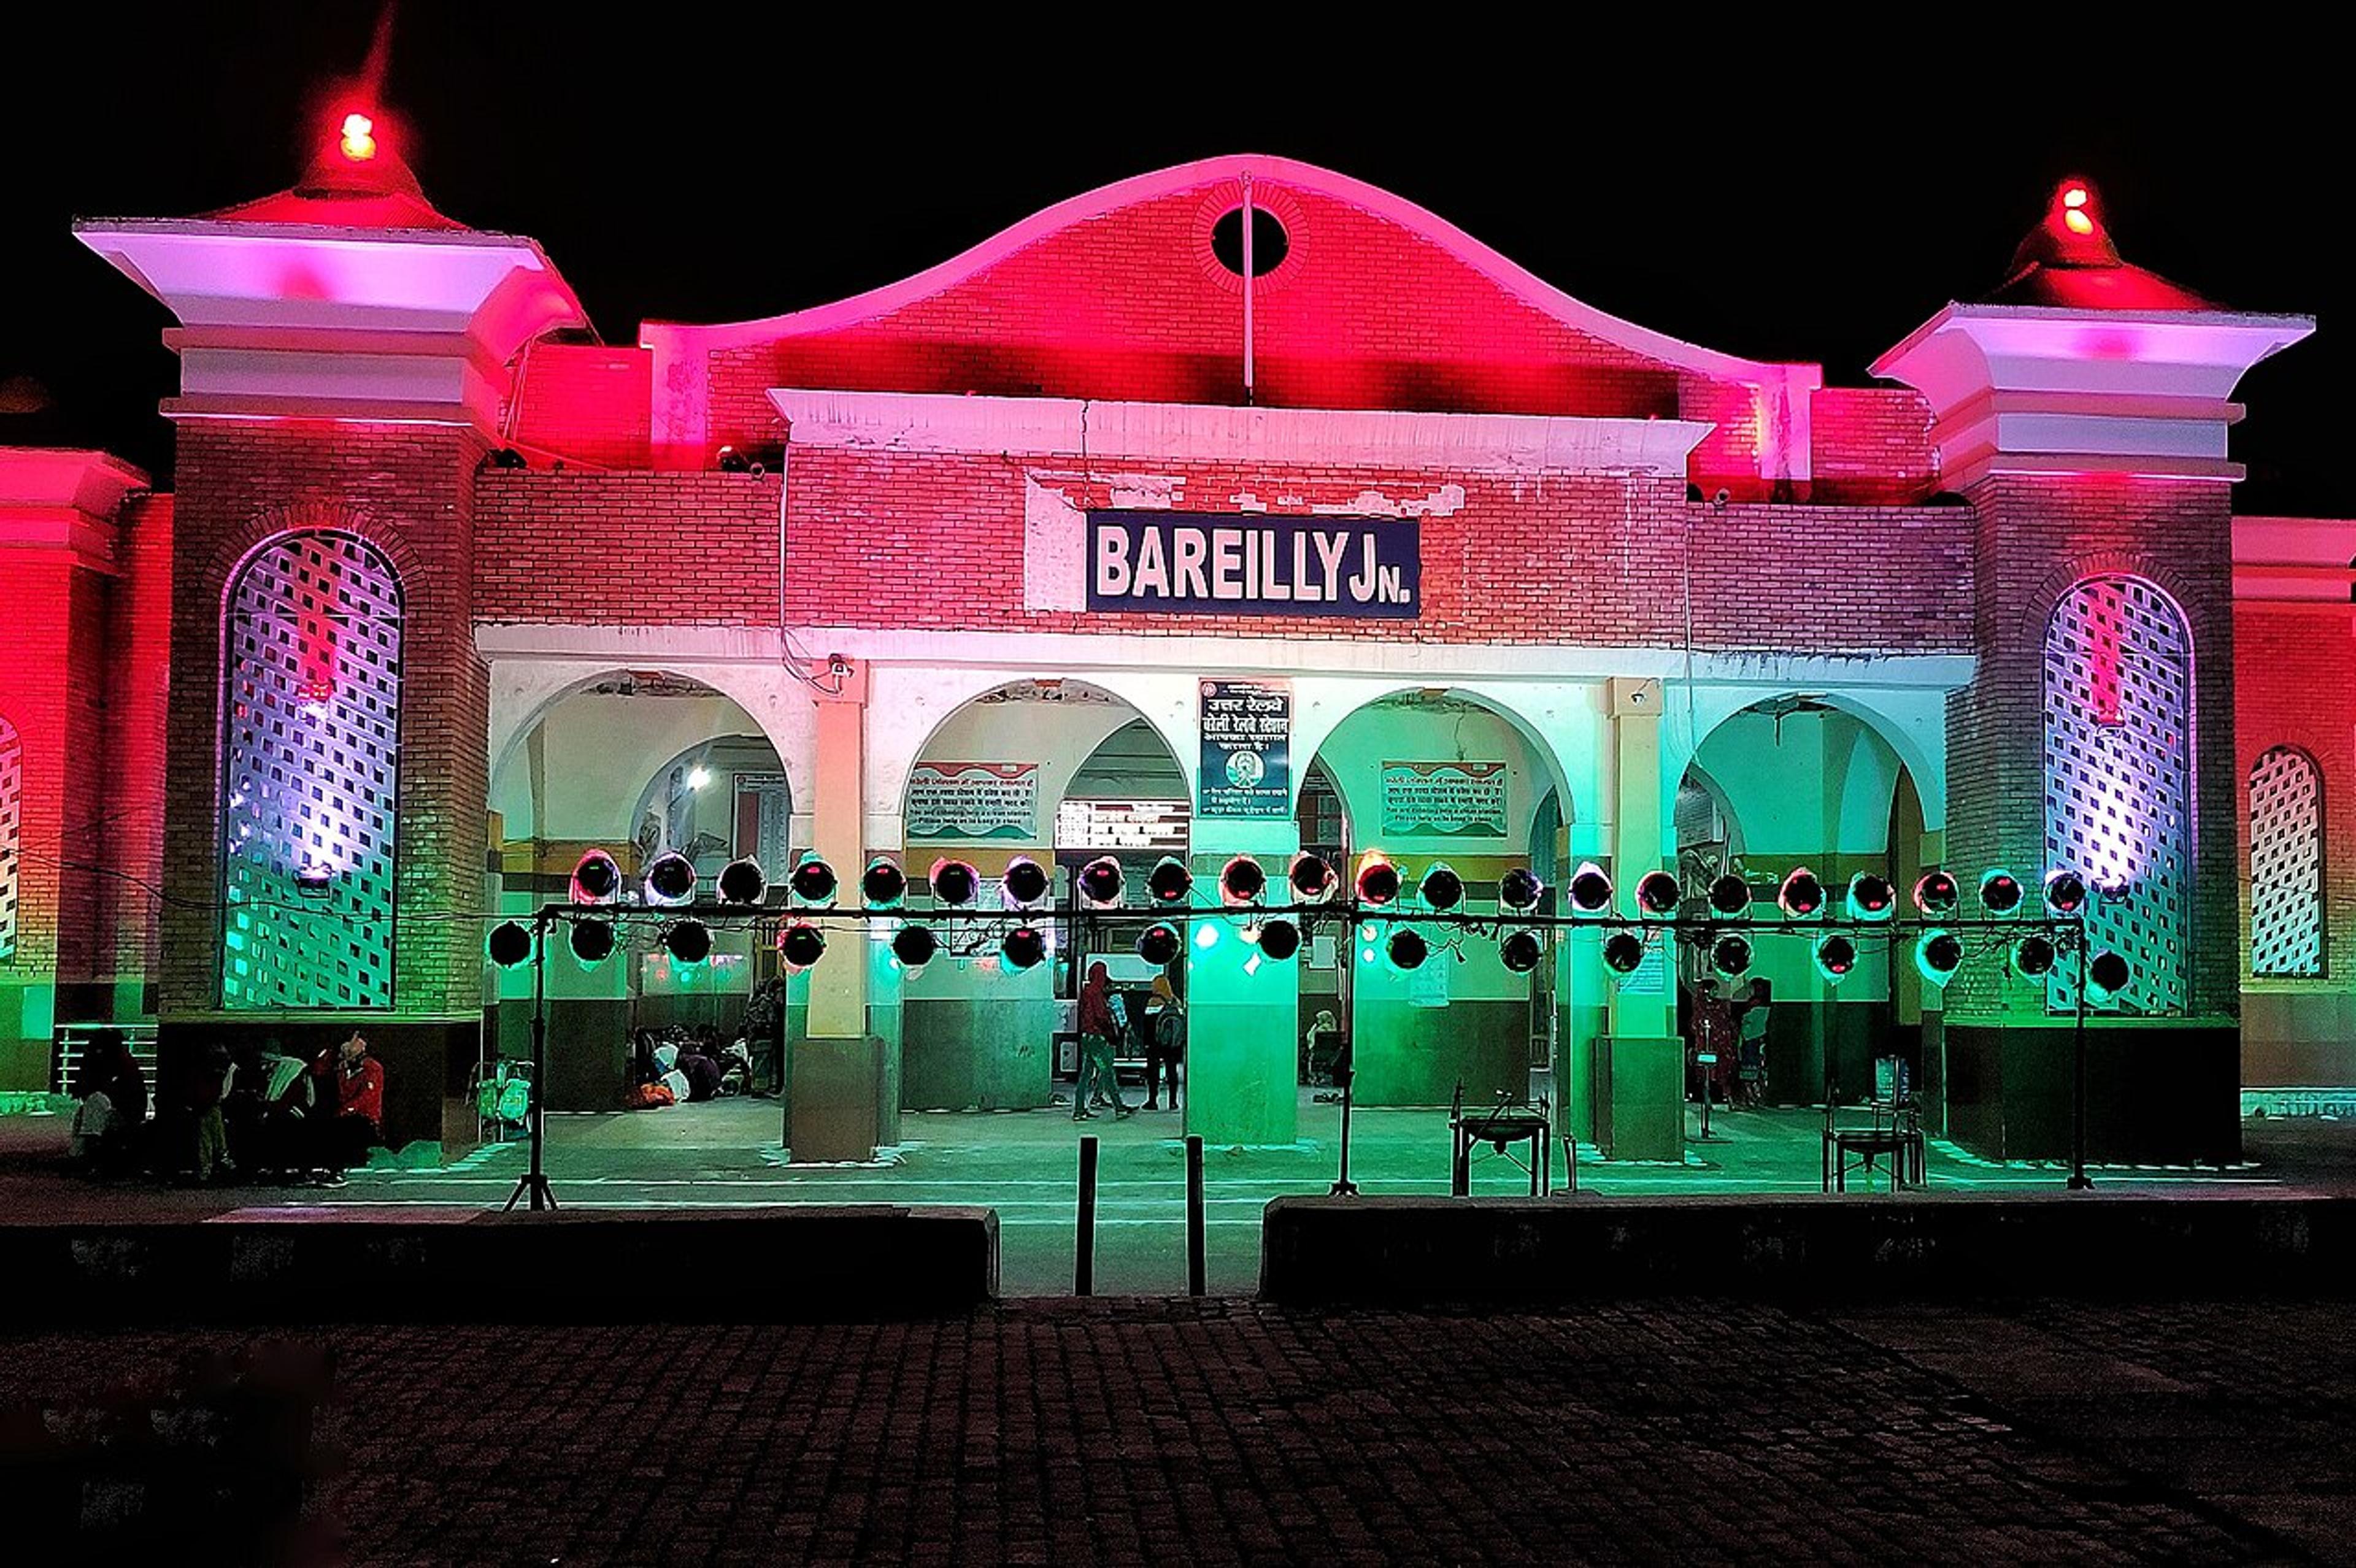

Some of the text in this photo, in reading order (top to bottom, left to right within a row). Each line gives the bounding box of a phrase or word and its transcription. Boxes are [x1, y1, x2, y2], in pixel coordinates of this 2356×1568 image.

[1096, 526, 1349, 601] BAREILLY
[1207, 696, 1283, 712] उत्तर रेलवे
[1231, 713, 1257, 733] रेलवे
